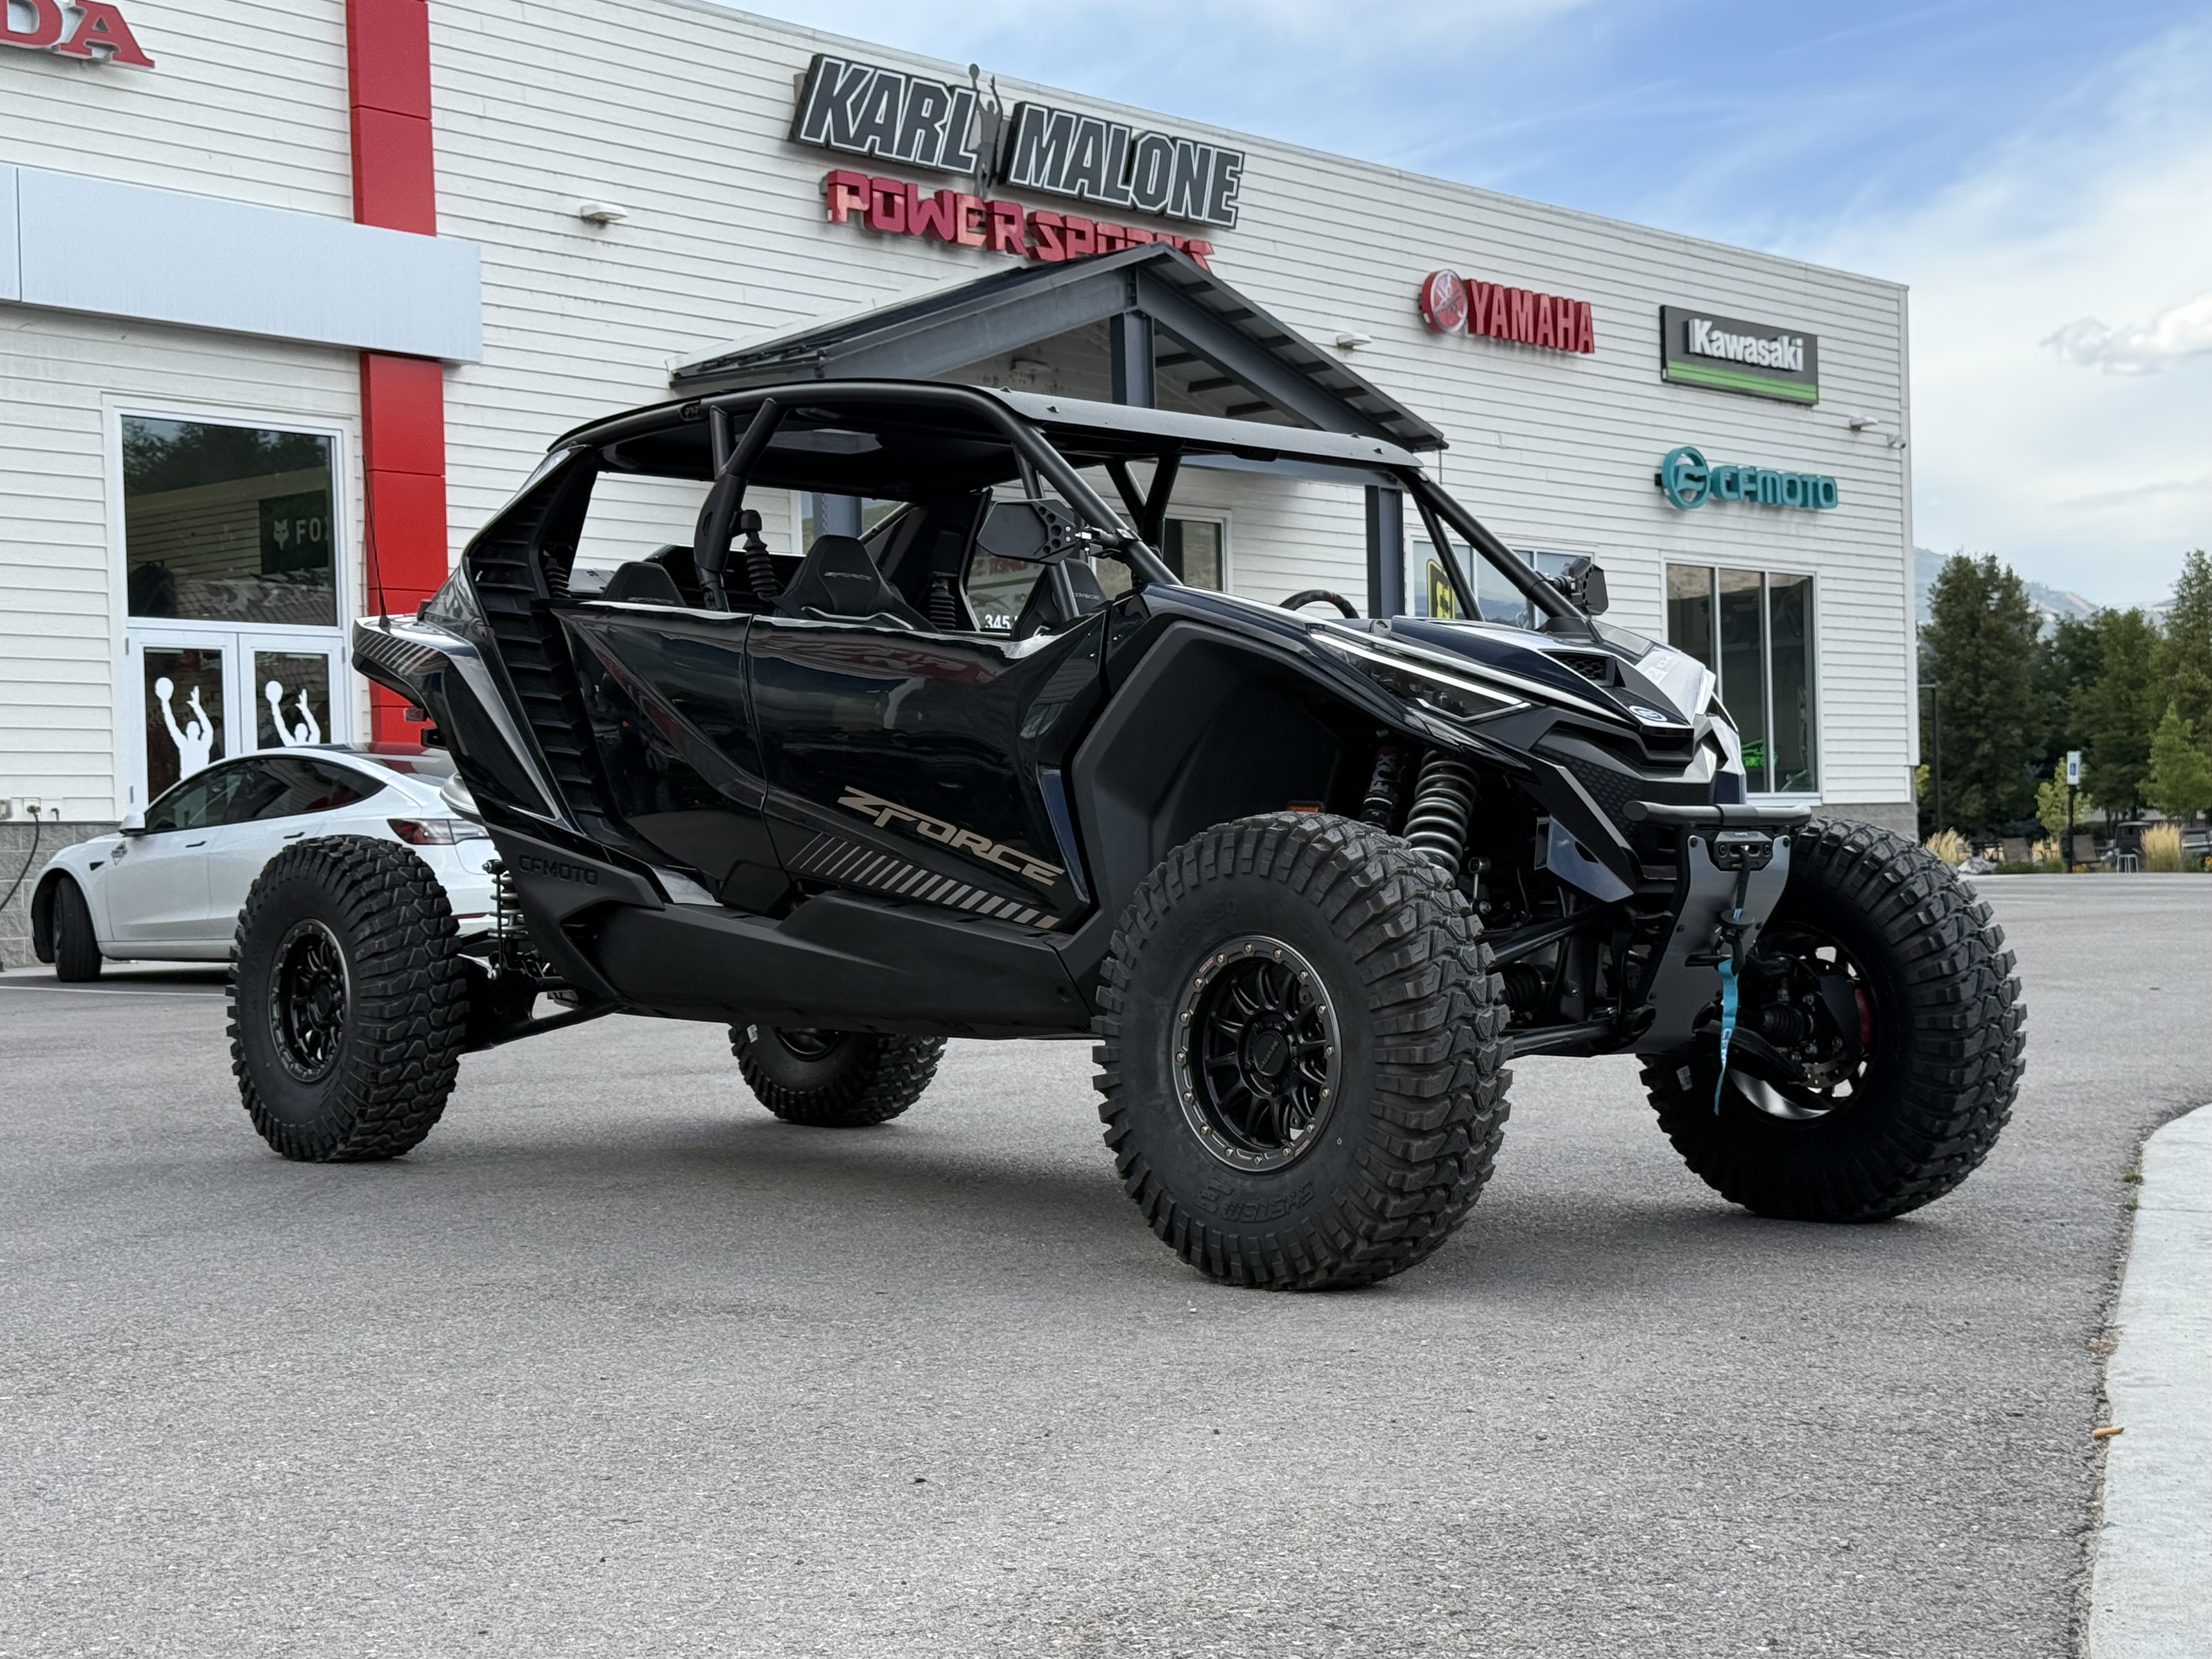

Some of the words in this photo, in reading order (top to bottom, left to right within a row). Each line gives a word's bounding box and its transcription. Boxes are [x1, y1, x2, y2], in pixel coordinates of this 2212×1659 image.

[789, 54, 979, 174] KARL
[1004, 102, 1245, 228] MALONE
[1464, 278, 1595, 354] YAMAHA
[1688, 318, 1804, 371] Kawasaki
[1712, 465, 1838, 509] CFMOTO
[295, 515, 328, 545] FO
[837, 785, 1065, 887] ZFORCE
[518, 854, 599, 887] CFMOTO
